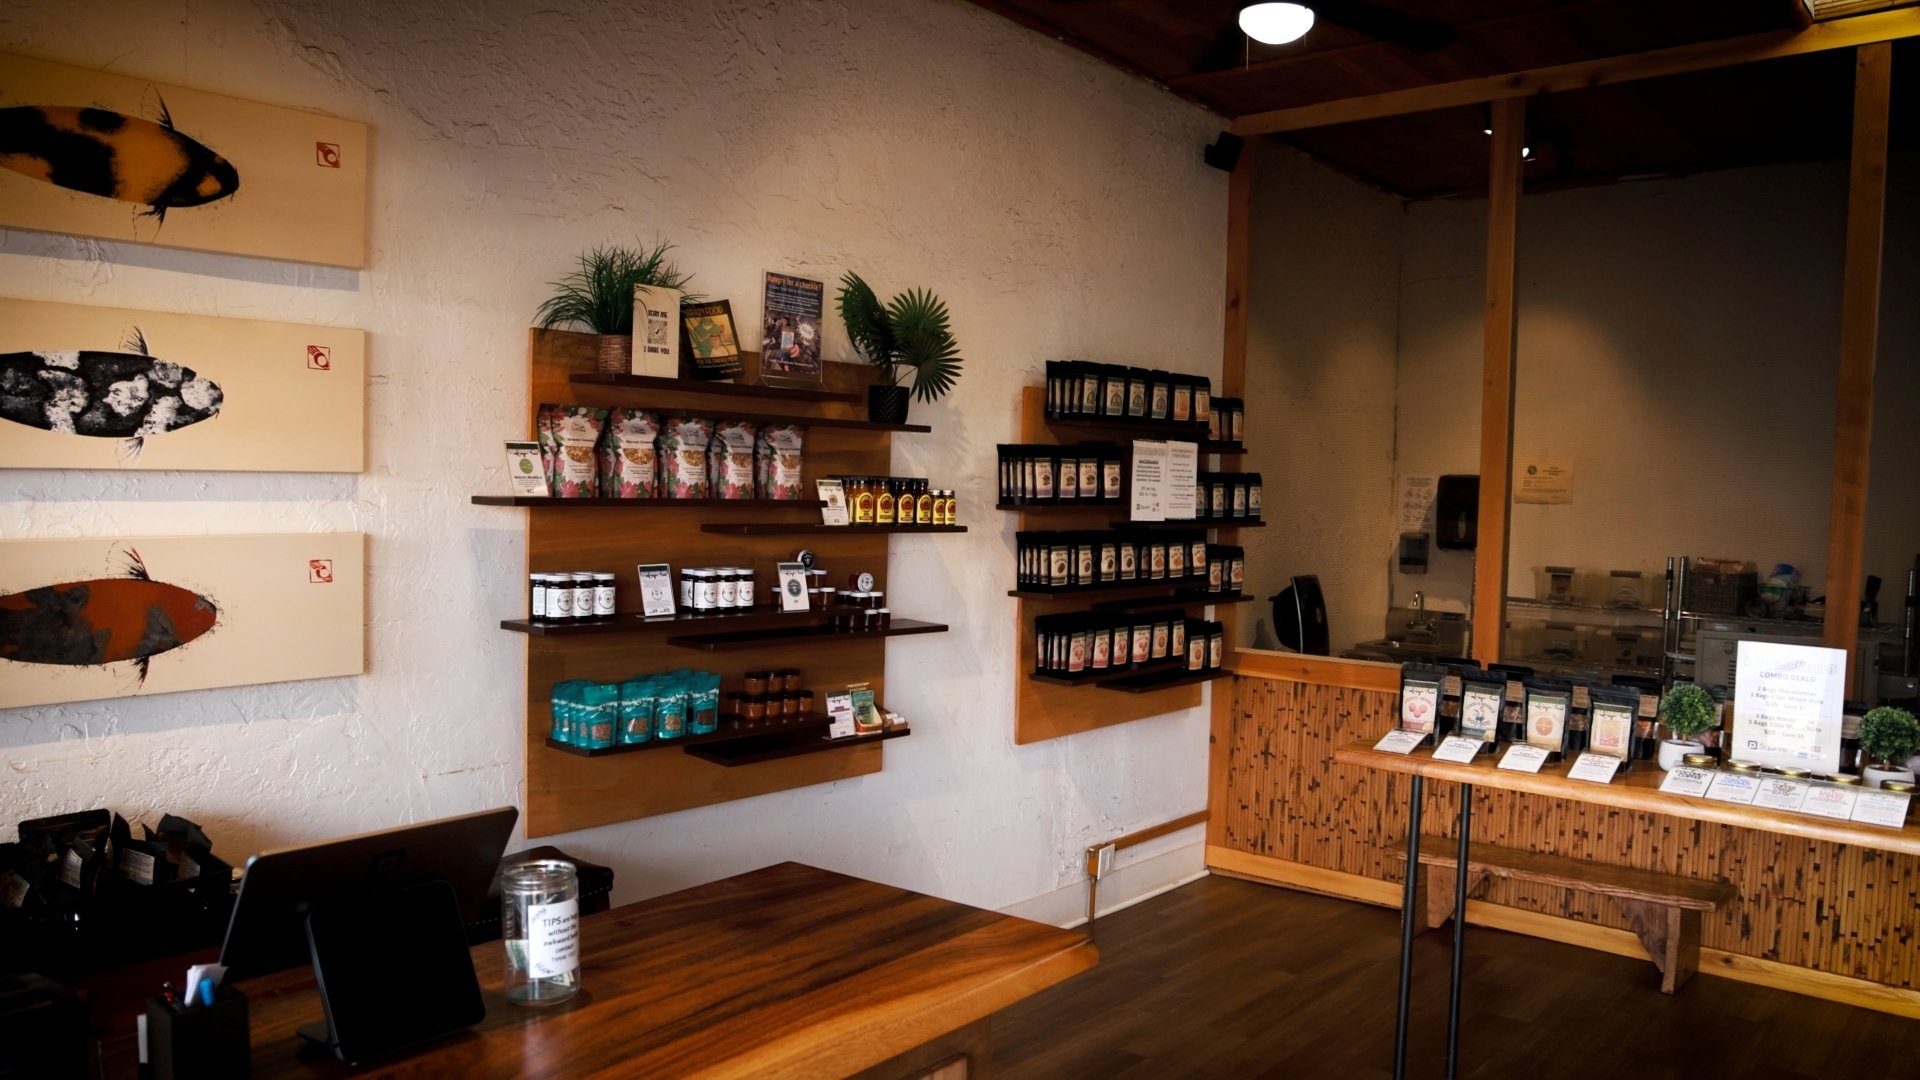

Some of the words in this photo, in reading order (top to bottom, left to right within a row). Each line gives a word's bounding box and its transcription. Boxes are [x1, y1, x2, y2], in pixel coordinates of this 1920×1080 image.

[1760, 672, 1788, 680] COMBO
[1790, 674, 1816, 682] DEALS!
[543, 916, 561, 927] TIPS
[548, 926, 570, 936] without
[544, 936, 570, 946] awkward
